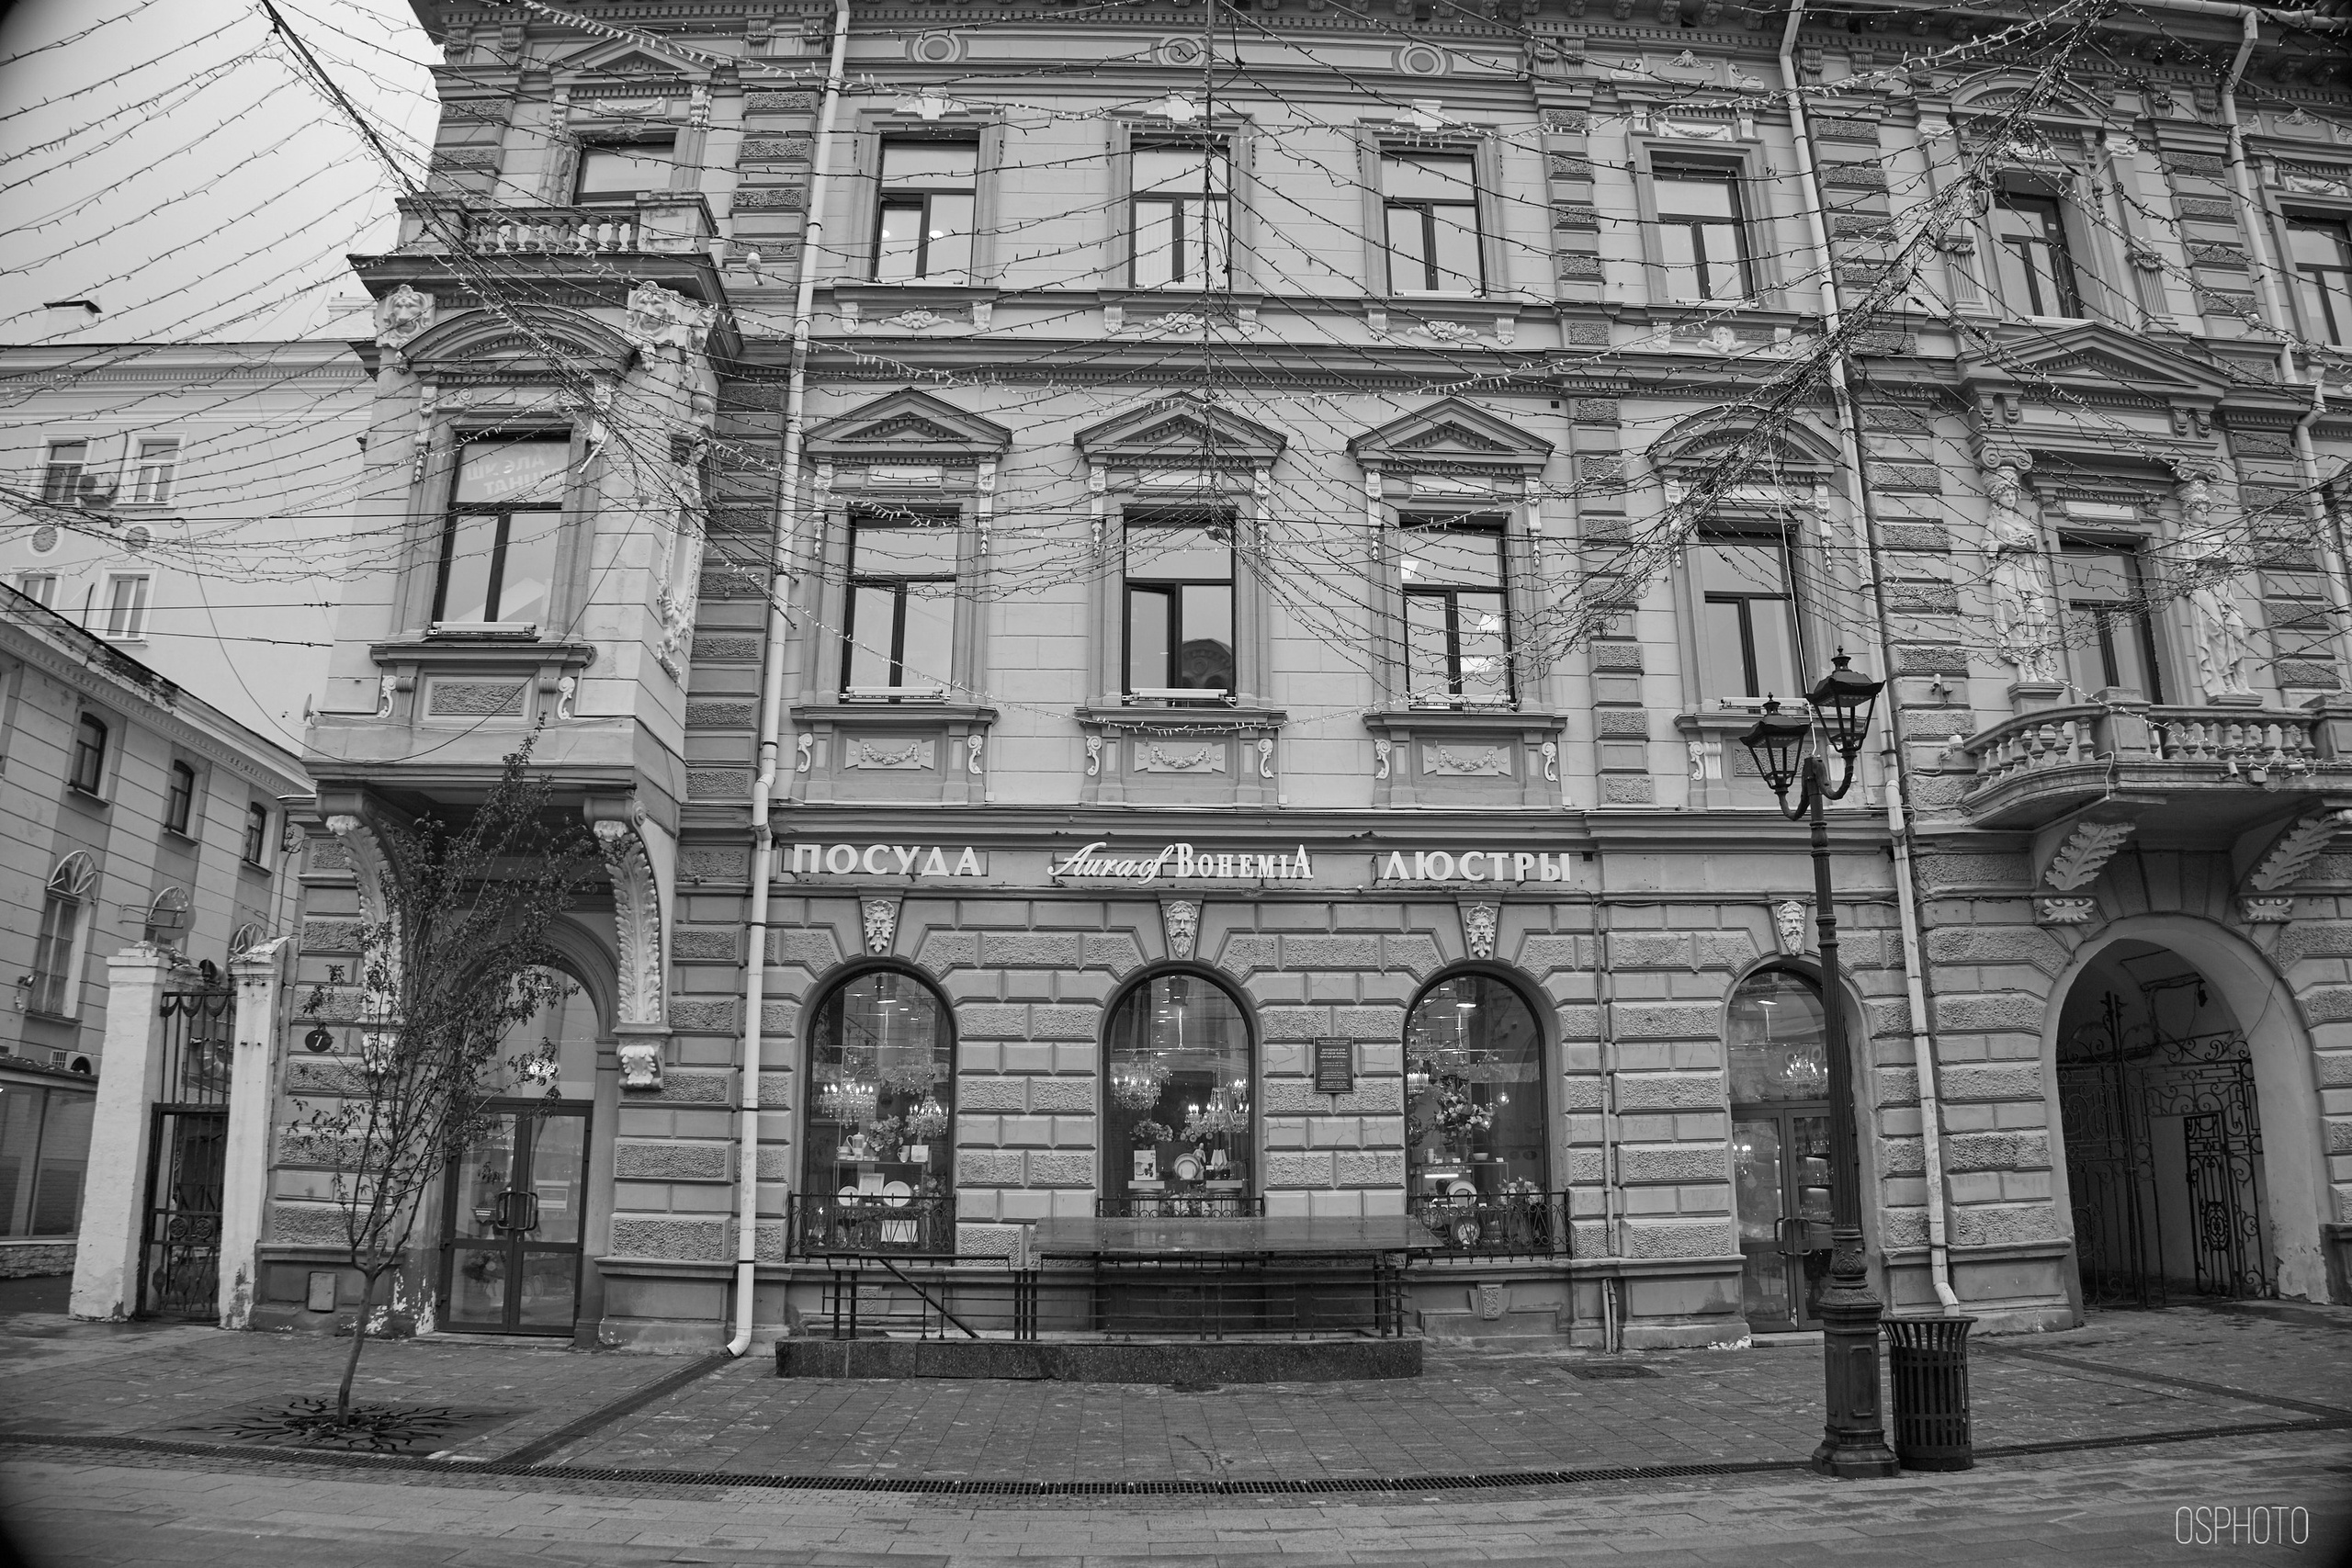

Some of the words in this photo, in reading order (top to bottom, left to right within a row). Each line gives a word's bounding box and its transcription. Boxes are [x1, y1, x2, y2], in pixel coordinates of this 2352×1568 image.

[793, 844, 982, 876] ПОСУДА
[1047, 842, 1139, 876] Aura
[1175, 843, 1314, 879] BOHEMIA
[1383, 851, 1571, 882] ЛЮСТРЫ
